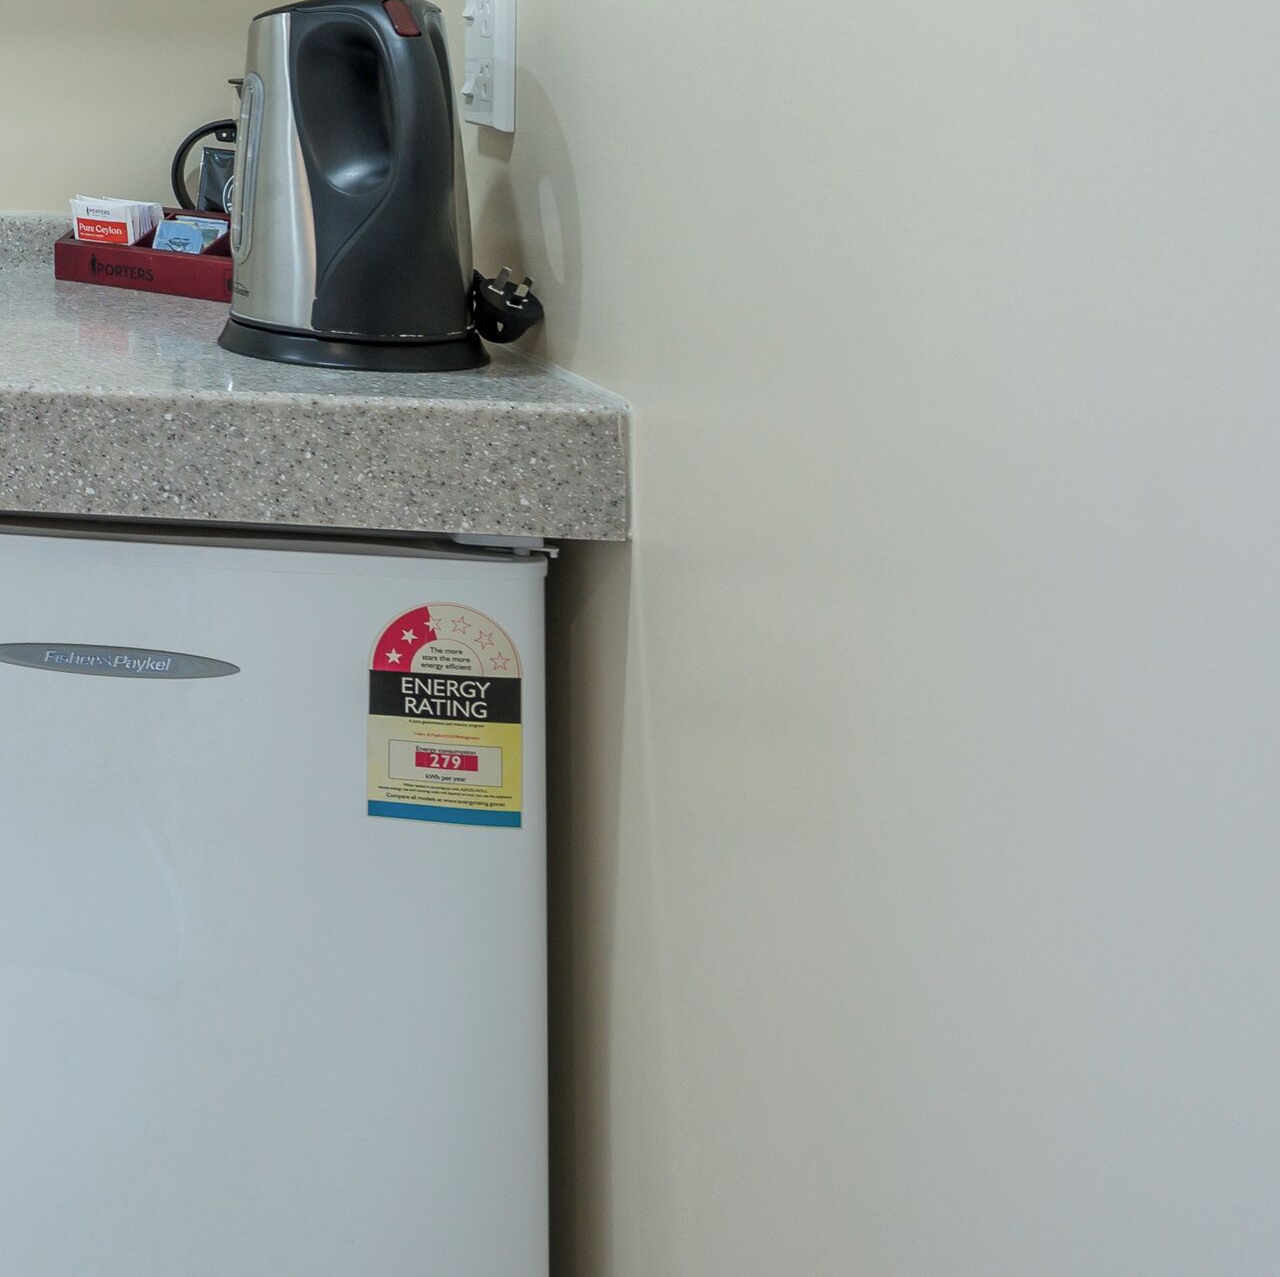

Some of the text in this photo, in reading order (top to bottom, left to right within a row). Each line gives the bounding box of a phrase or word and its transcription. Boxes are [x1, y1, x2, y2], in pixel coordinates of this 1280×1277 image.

[79, 223, 95, 232] Pure
[95, 224, 122, 236] Ceylon
[96, 263, 154, 281] PORTERS
[430, 646, 443, 654] The
[401, 676, 491, 699] ENERGY
[404, 696, 488, 719] RATING
[430, 754, 461, 769] 279
